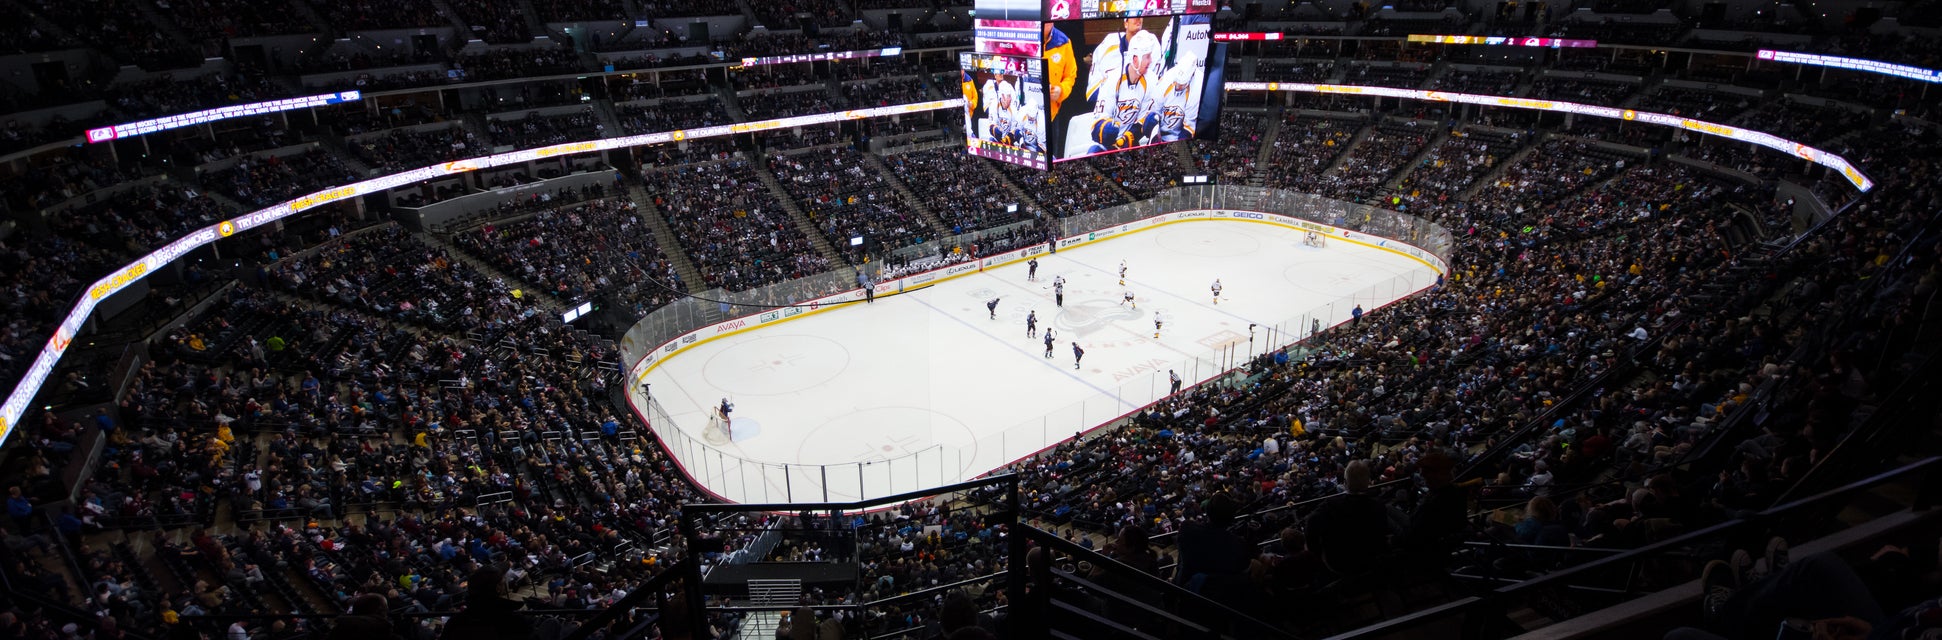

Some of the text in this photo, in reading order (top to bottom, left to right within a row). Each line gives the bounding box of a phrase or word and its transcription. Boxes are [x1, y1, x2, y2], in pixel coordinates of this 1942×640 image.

[1578, 106, 1620, 117] SANDWICHES
[498, 154, 517, 164] OUR
[624, 134, 670, 146] SANDWICHES
[236, 217, 252, 230] TRY
[253, 212, 272, 224] OUR
[272, 205, 290, 218] NEW
[290, 187, 356, 212] FRESH-CRACKED
[387, 168, 436, 186] SANDWICHES
[1233, 212, 1264, 220] GEICO
[1274, 216, 1300, 226] CAMBRIA
[156, 249, 172, 263] EGG
[170, 229, 216, 257] SANDWICHES
[954, 264, 976, 273] LEXUS
[875, 284, 890, 294] Clips
[716, 320, 746, 333] AVAYA
[1112, 357, 1169, 382] AVAYA
[13, 386, 29, 414] EGG
